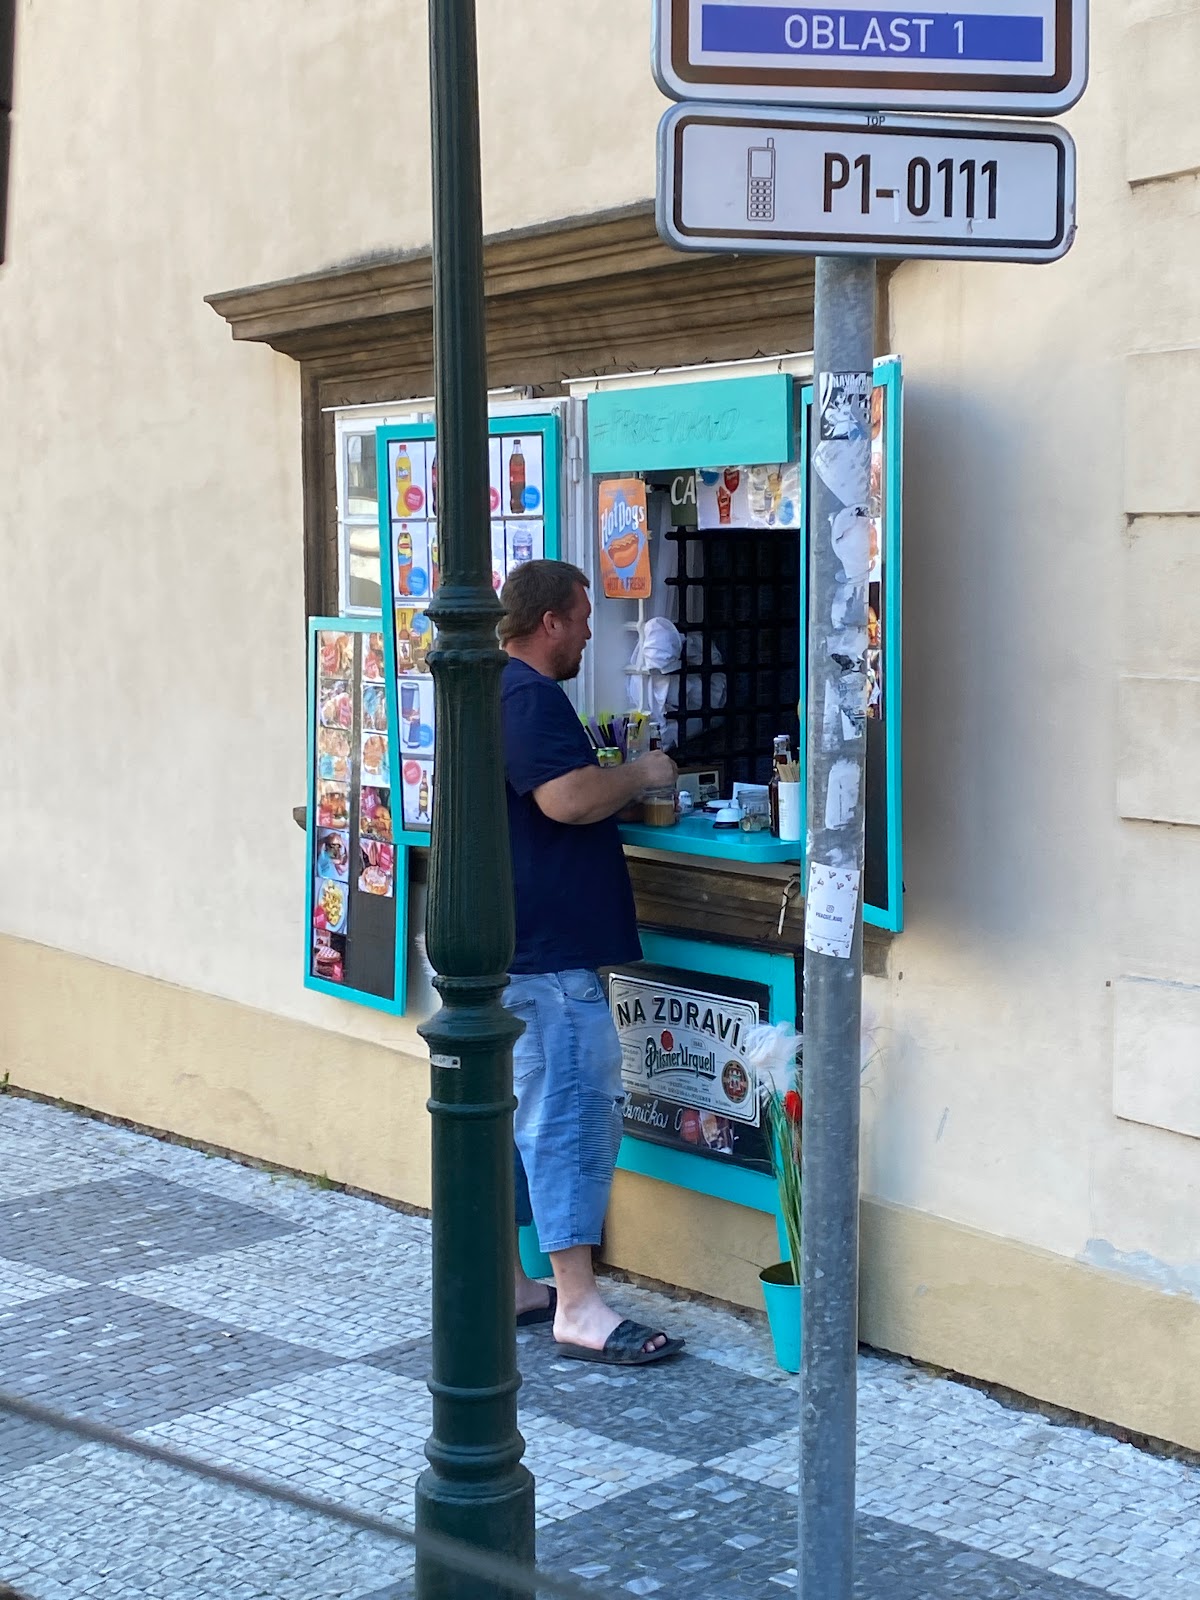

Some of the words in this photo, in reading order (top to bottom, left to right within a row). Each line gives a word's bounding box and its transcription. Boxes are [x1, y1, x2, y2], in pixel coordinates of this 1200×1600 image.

[784, 14, 934, 53] OBLAST
[953, 20, 965, 54] 1
[865, 115, 886, 126] TOP
[601, 503, 618, 549] Hot
[618, 501, 645, 532] Dogs
[616, 997, 647, 1028] NA
[645, 1035, 681, 1079] Pilsner
[680, 1043, 716, 1079] Urquell
